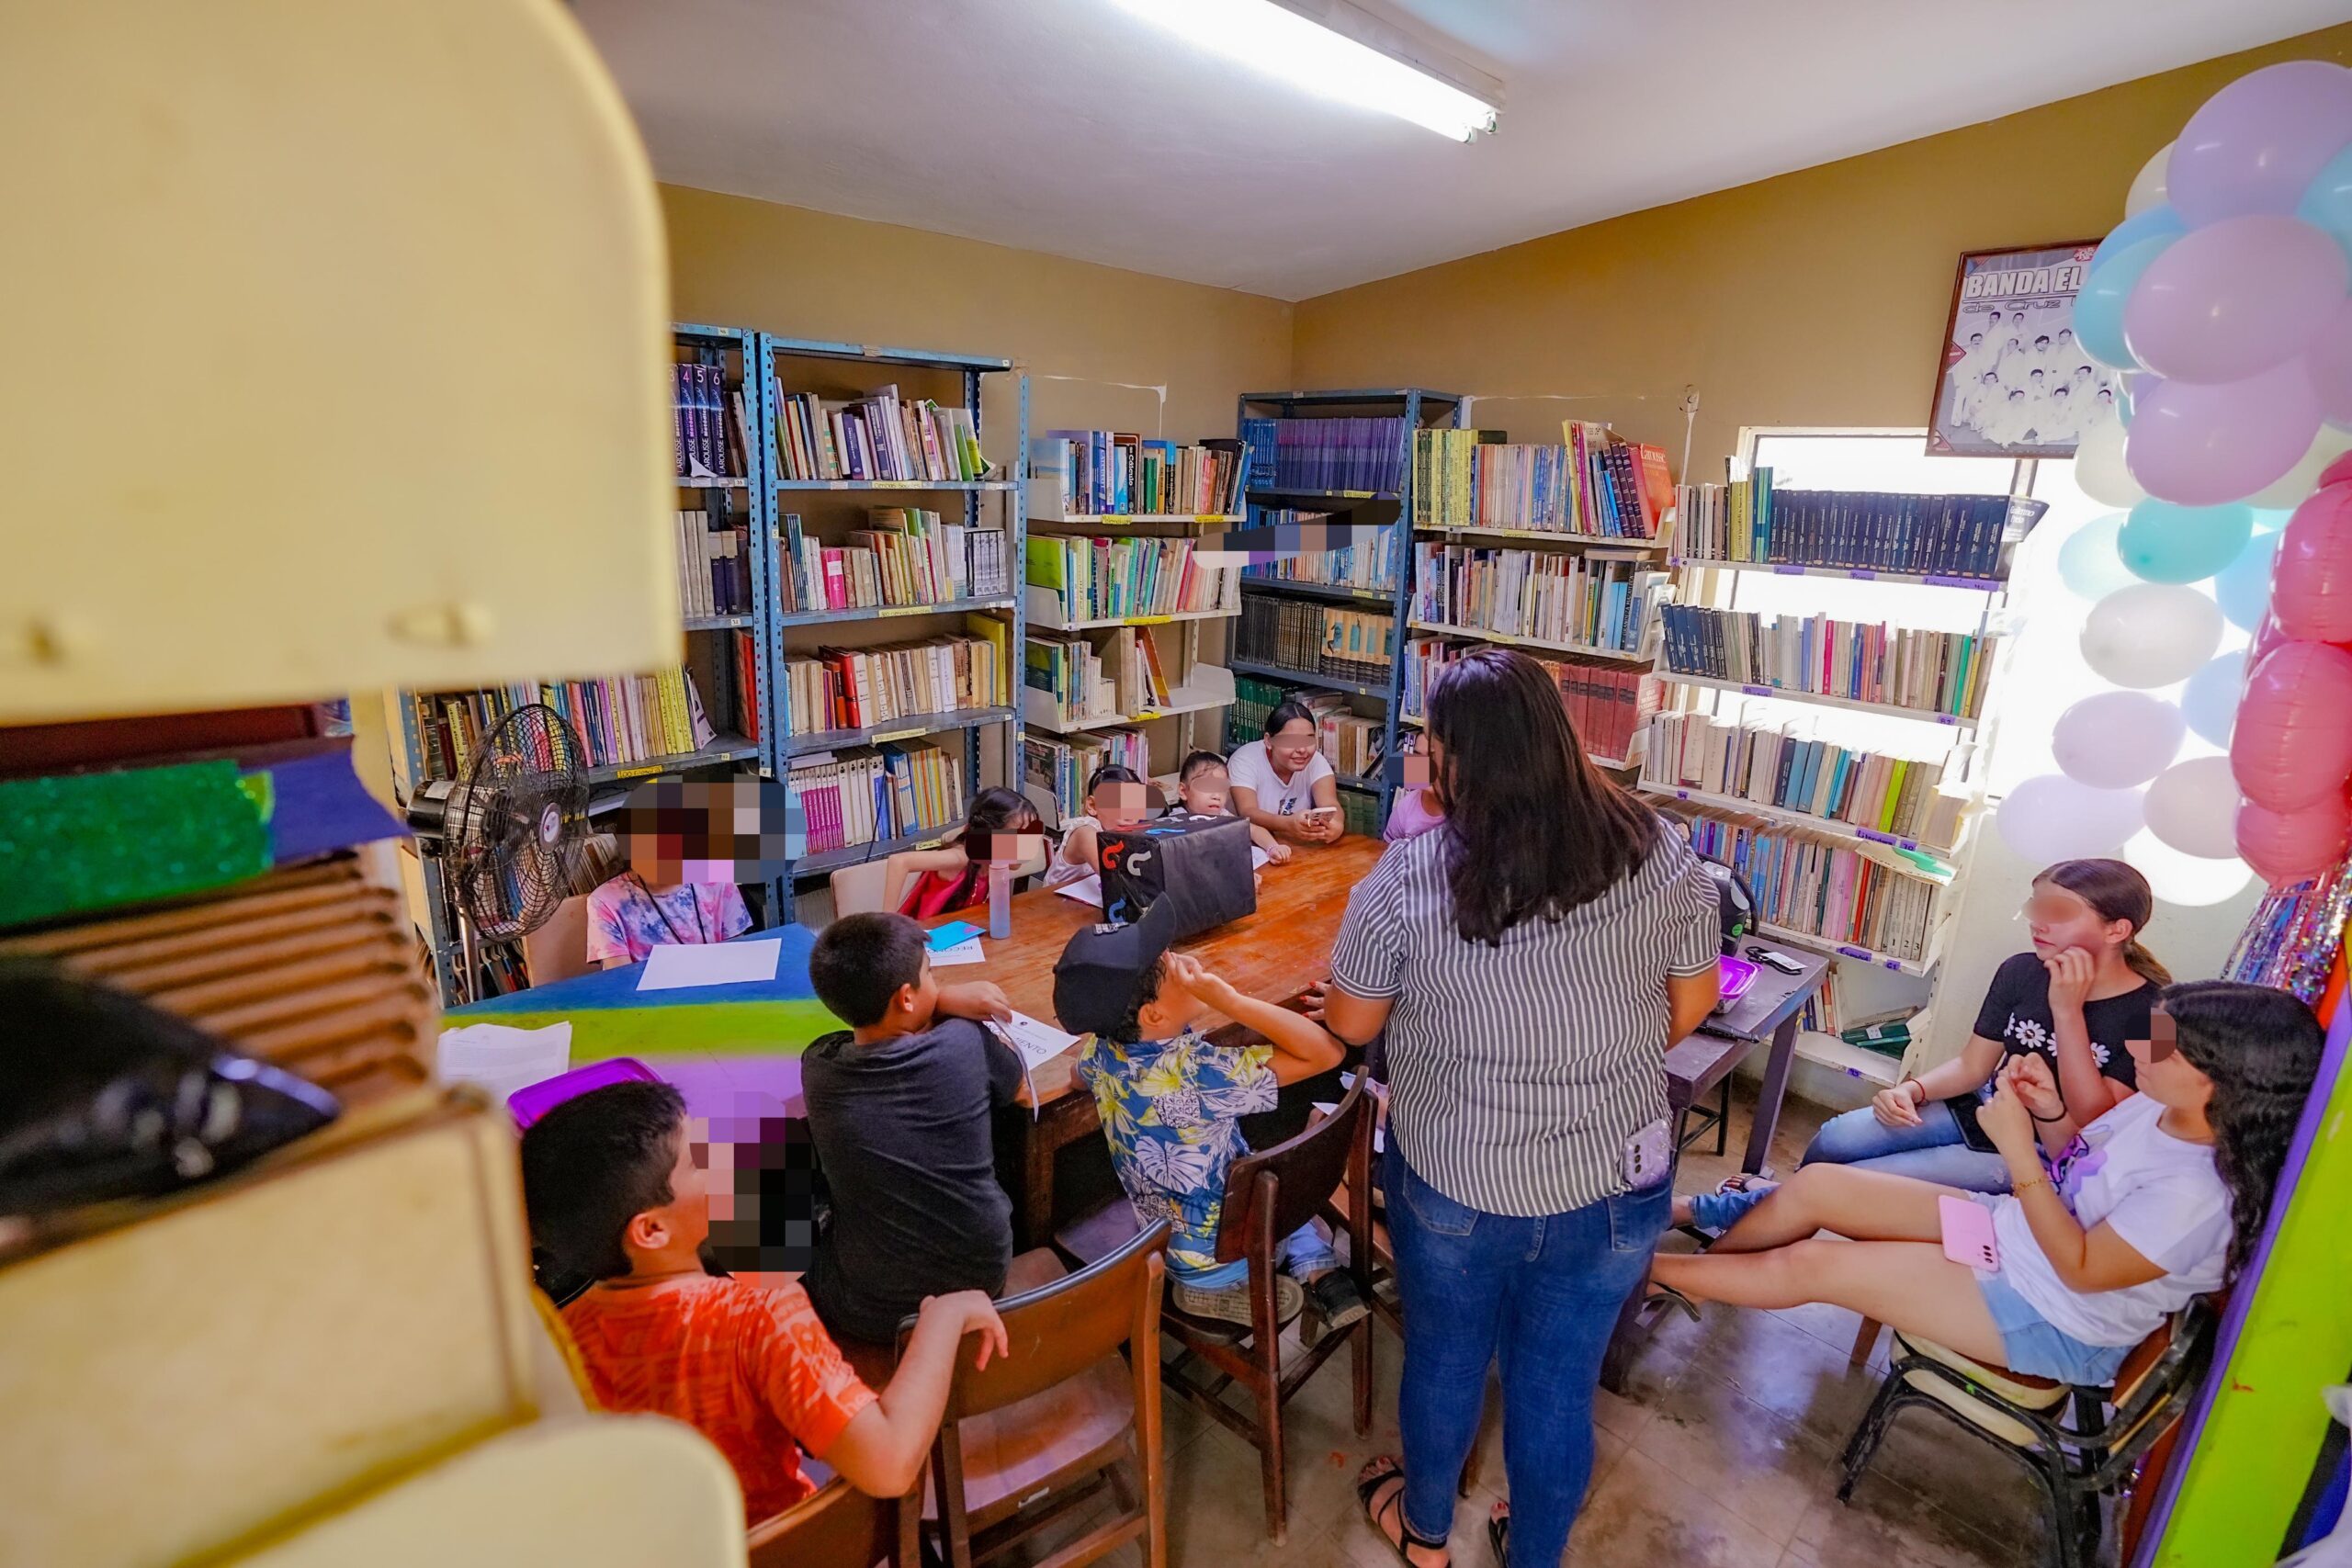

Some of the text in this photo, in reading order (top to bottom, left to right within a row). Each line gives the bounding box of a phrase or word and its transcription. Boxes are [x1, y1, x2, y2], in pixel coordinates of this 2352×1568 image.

[1965, 266, 2081, 299] BANDA EL
[1962, 302, 1995, 314] de
[2005, 300, 2061, 311] Cruz
[683, 370, 690, 383] 4
[697, 370, 704, 383] 5
[713, 372, 720, 385] 6
[675, 438, 684, 473] LAROUSSE
[688, 438, 696, 458] OUSSE
[718, 440, 726, 474] LAROUSSE
